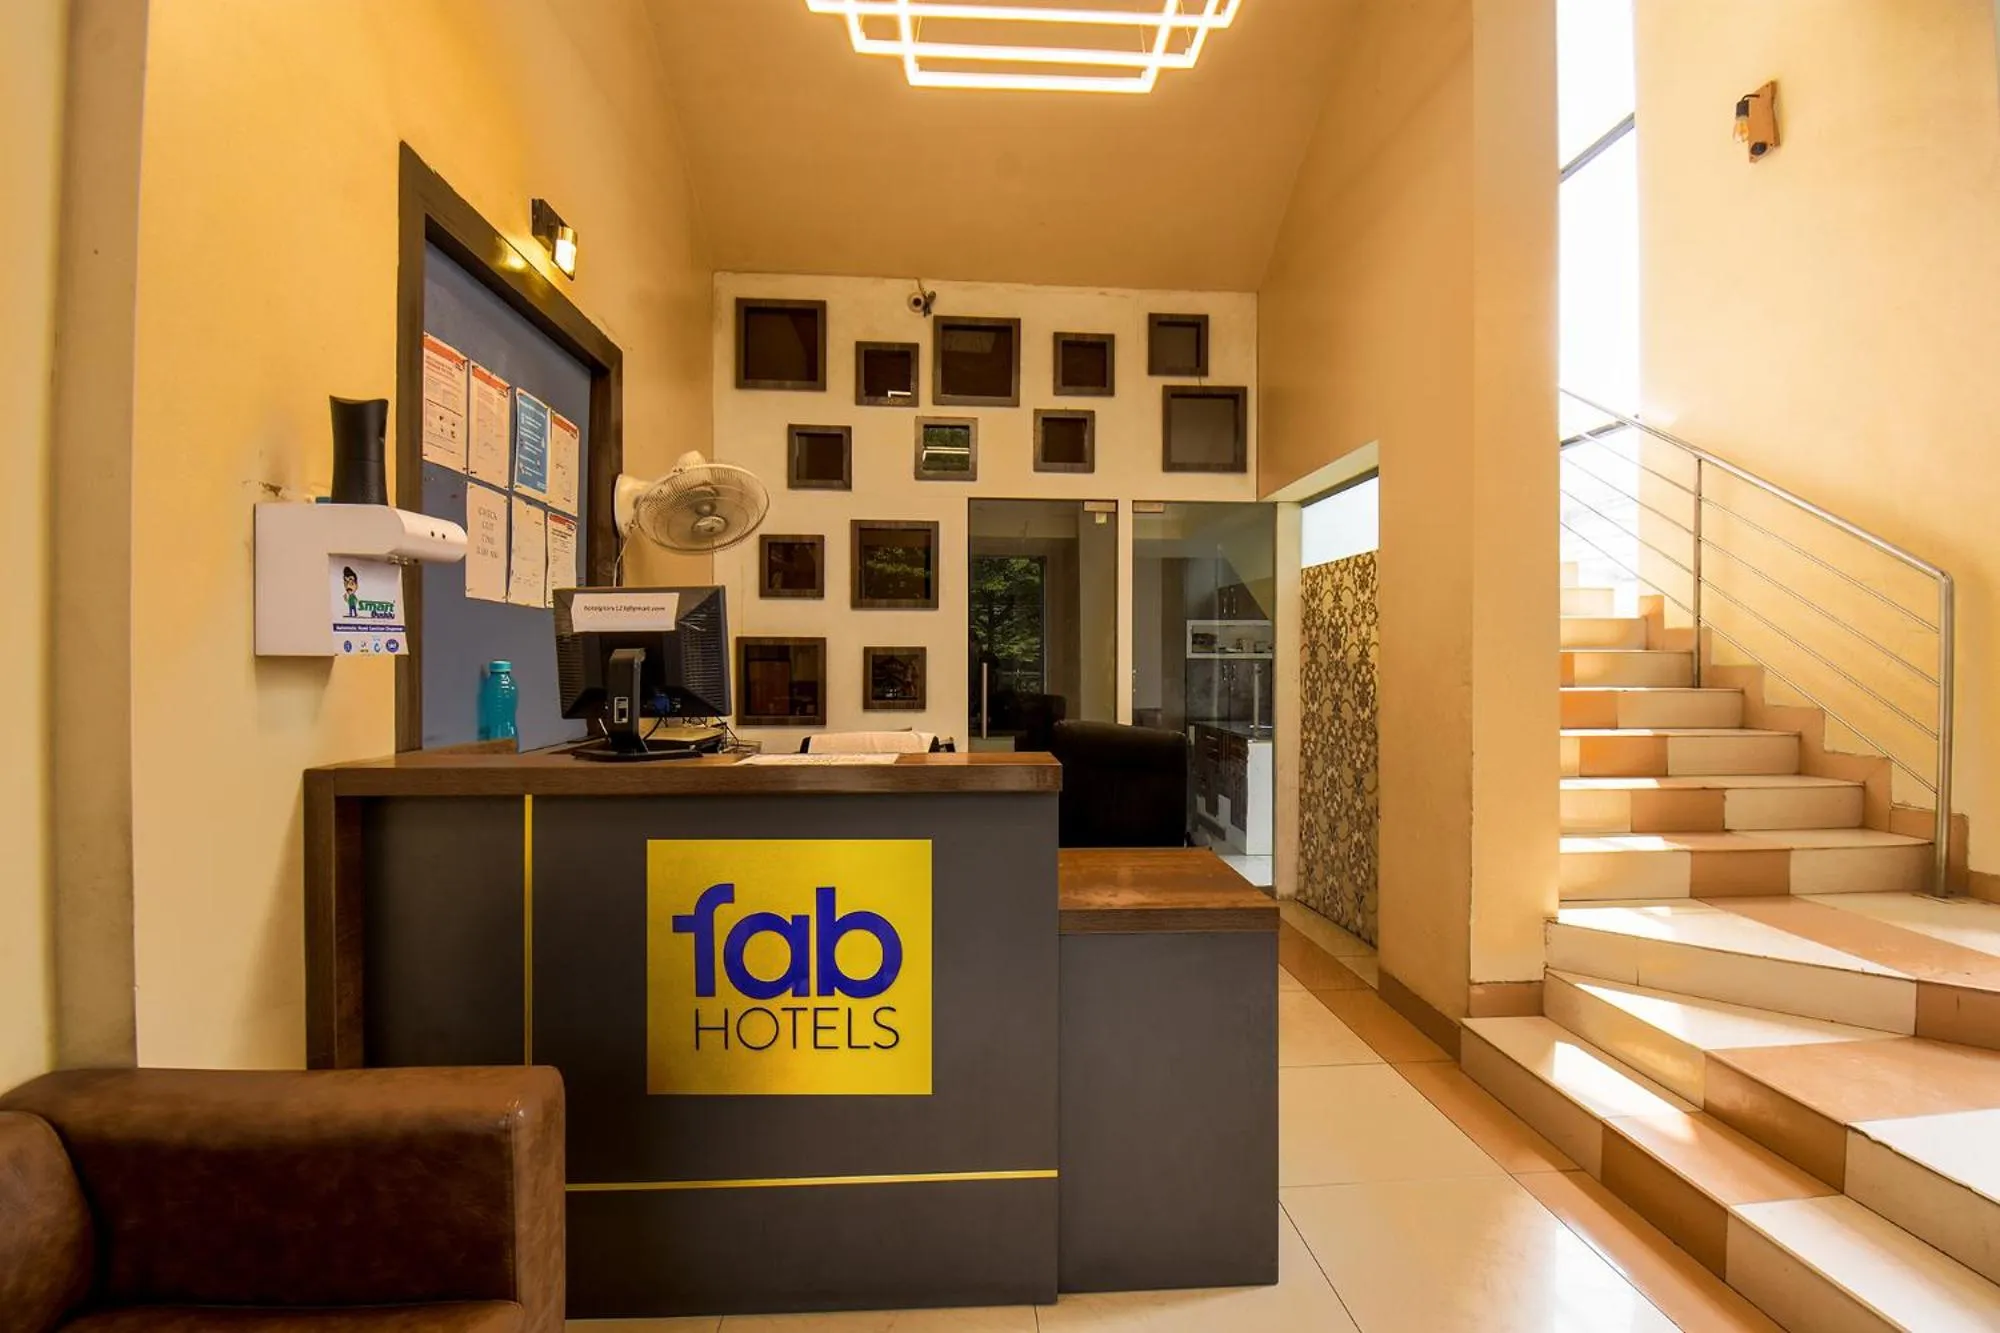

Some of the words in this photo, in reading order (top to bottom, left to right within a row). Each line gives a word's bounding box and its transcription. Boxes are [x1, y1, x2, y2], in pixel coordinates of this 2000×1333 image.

[358, 600, 394, 613] Smart
[672, 882, 904, 1000] fab
[695, 1006, 900, 1051] HOTELS
